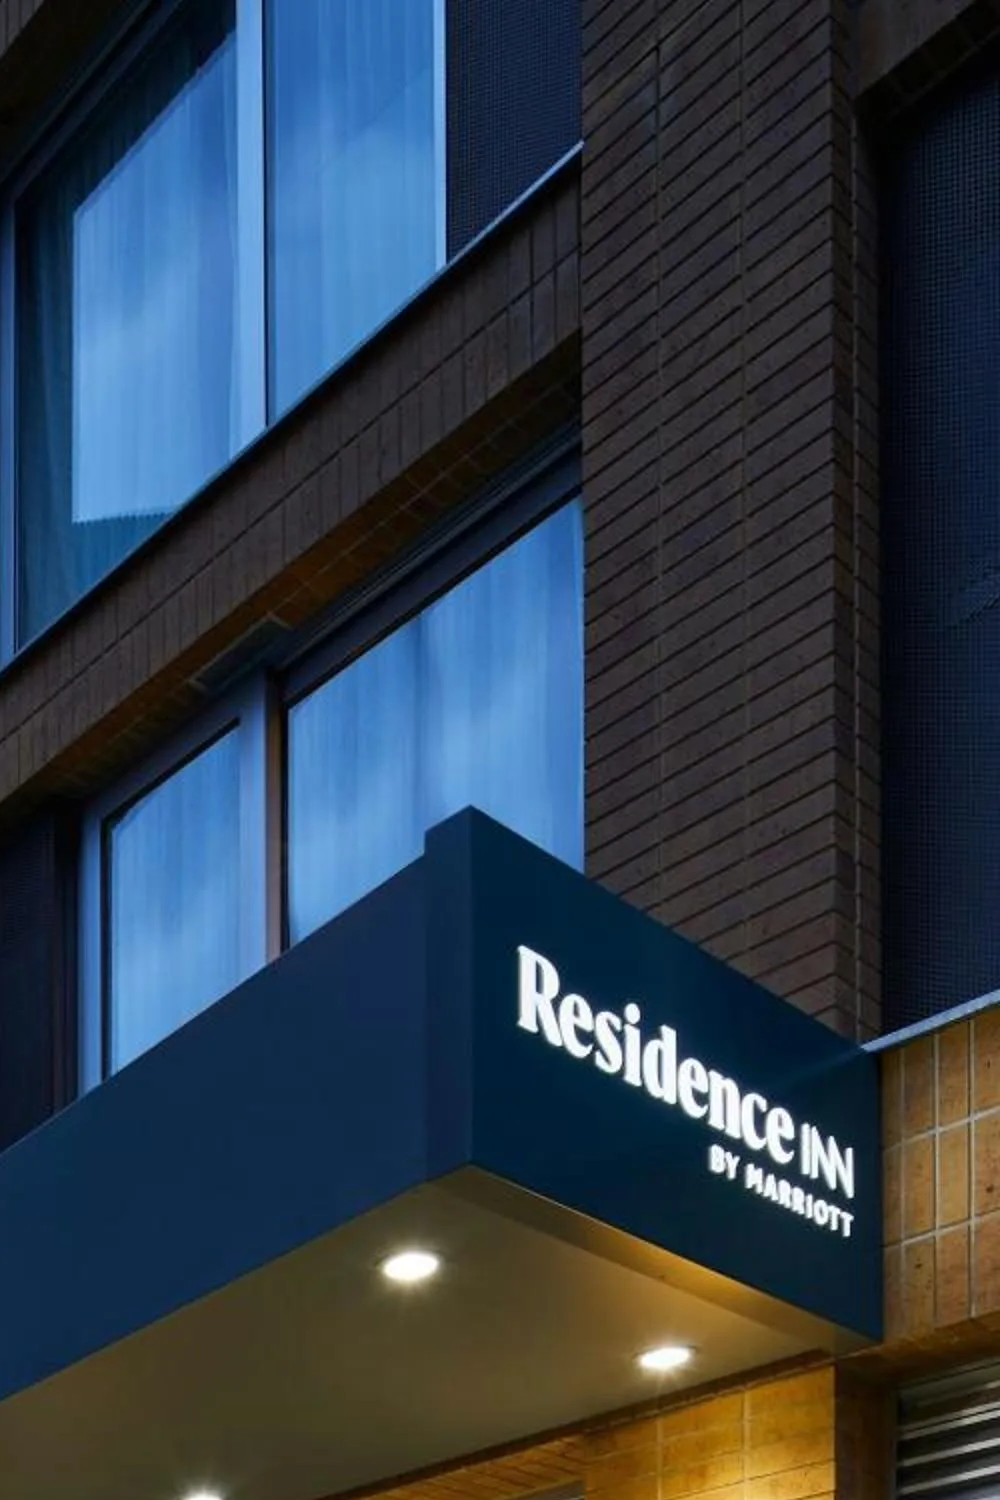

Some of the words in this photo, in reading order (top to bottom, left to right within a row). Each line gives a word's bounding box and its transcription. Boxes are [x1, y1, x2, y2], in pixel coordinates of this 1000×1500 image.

[516, 945, 796, 1164] Residence
[801, 1123, 855, 1199] INN
[708, 1144, 740, 1180] BY
[745, 1163, 855, 1238] MARRIOTT
